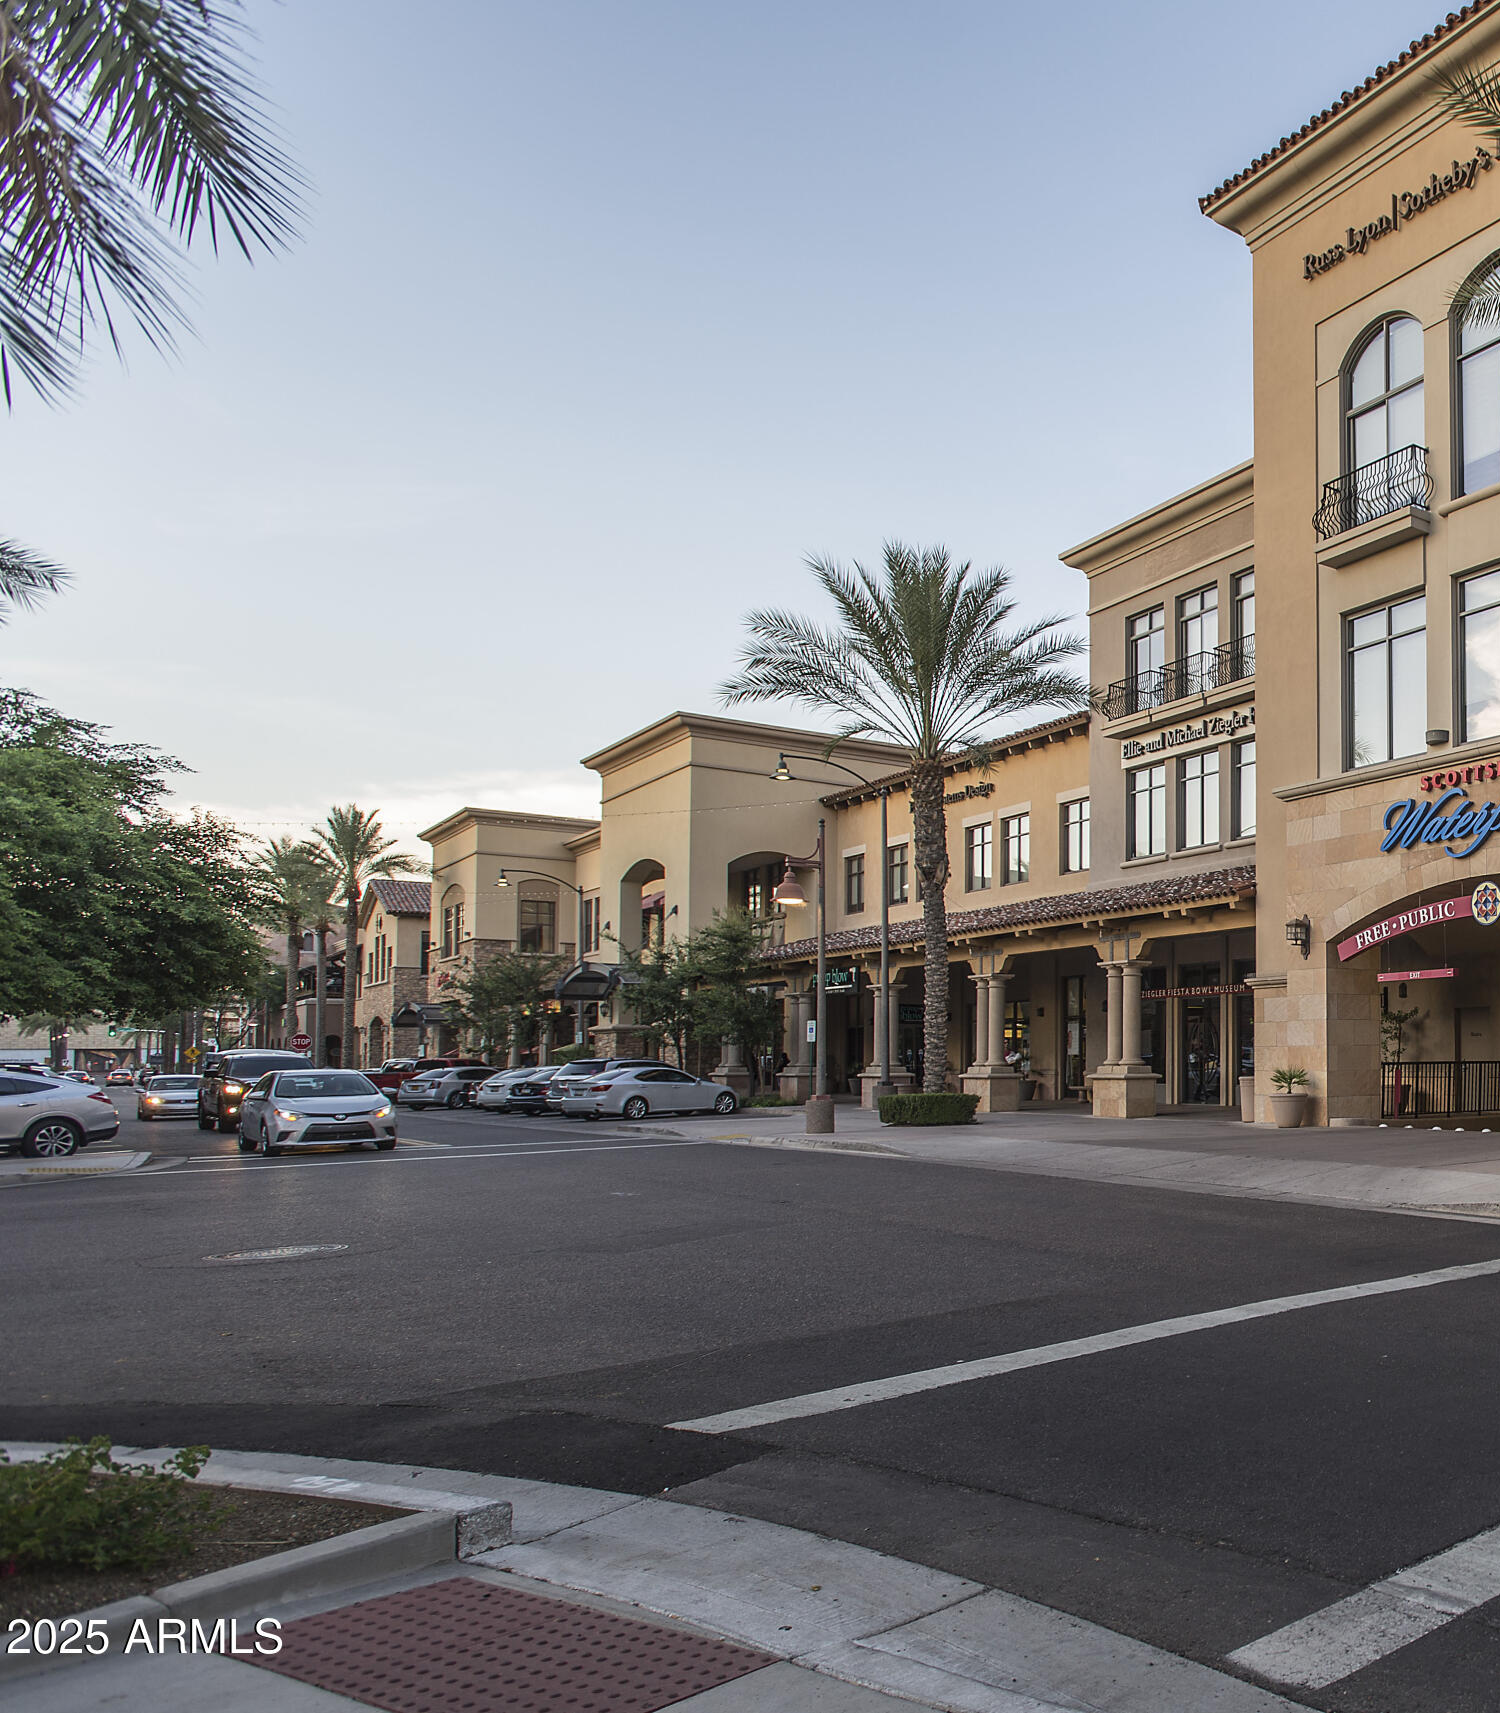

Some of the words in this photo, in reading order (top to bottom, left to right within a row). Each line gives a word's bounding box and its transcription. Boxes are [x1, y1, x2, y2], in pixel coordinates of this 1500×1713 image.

[1303, 244, 1346, 282] Russ
[1345, 214, 1392, 255] Lyon
[1399, 146, 1494, 221] Sotheby's
[1122, 740, 1145, 759] Ellie
[1145, 732, 1166, 752] and
[1167, 719, 1208, 747] Michael
[1208, 710, 1249, 737] Ziegler
[1355, 921, 1391, 950] FREE
[1398, 901, 1456, 931] PUBLIC
[1141, 989, 1166, 999] ZIEGLER
[1167, 987, 1189, 997] FIESTA
[1191, 985, 1213, 995] BOWL
[1214, 983, 1246, 994] MUSEUM
[1409, 971, 1421, 980] EXIT
[292, 1038, 311, 1046] STOP
